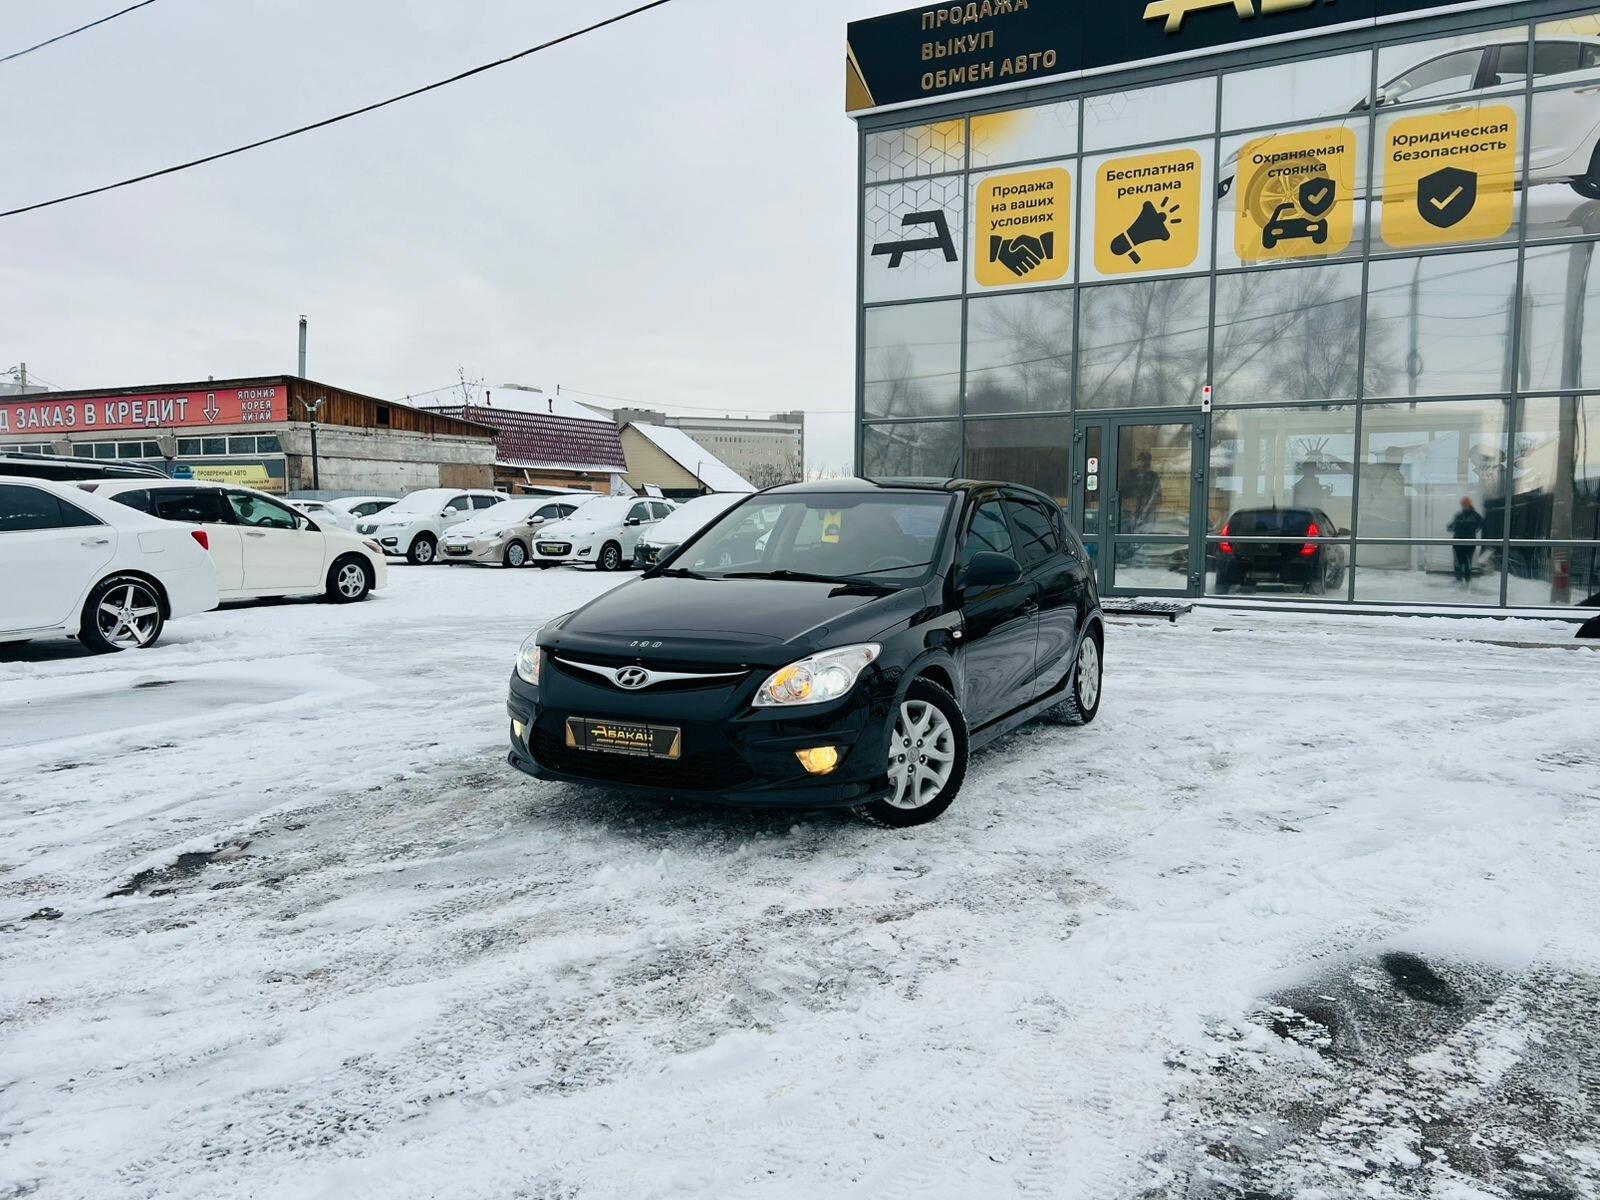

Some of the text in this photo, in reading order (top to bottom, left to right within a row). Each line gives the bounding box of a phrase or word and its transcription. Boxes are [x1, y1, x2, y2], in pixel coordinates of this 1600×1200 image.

[921, 0, 1029, 31] ПРОДАЖА
[921, 30, 995, 61] ВЫКУП
[920, 49, 1058, 91] ОБМЕН АВТО
[1392, 123, 1509, 147] Юридическая
[1252, 144, 1345, 165] Охраняемая
[1392, 141, 1507, 162] безопасность
[1106, 161, 1195, 182] Бесплатная
[1267, 162, 1327, 179] стоянка
[992, 179, 1054, 197] Продажа
[1117, 178, 1182, 199] реклама
[991, 197, 1054, 213] на ваших
[990, 211, 1054, 231] условиях
[237, 388, 275, 400] ЯПОНИЯ
[16, 405, 77, 430] ЗАКАЗ
[84, 403, 97, 425] В
[105, 397, 189, 426] КРЕДИТ
[241, 400, 272, 411] КОРЕЯ
[241, 410, 272, 422] КИТАЙ
[591, 724, 654, 742] АБАКАН
